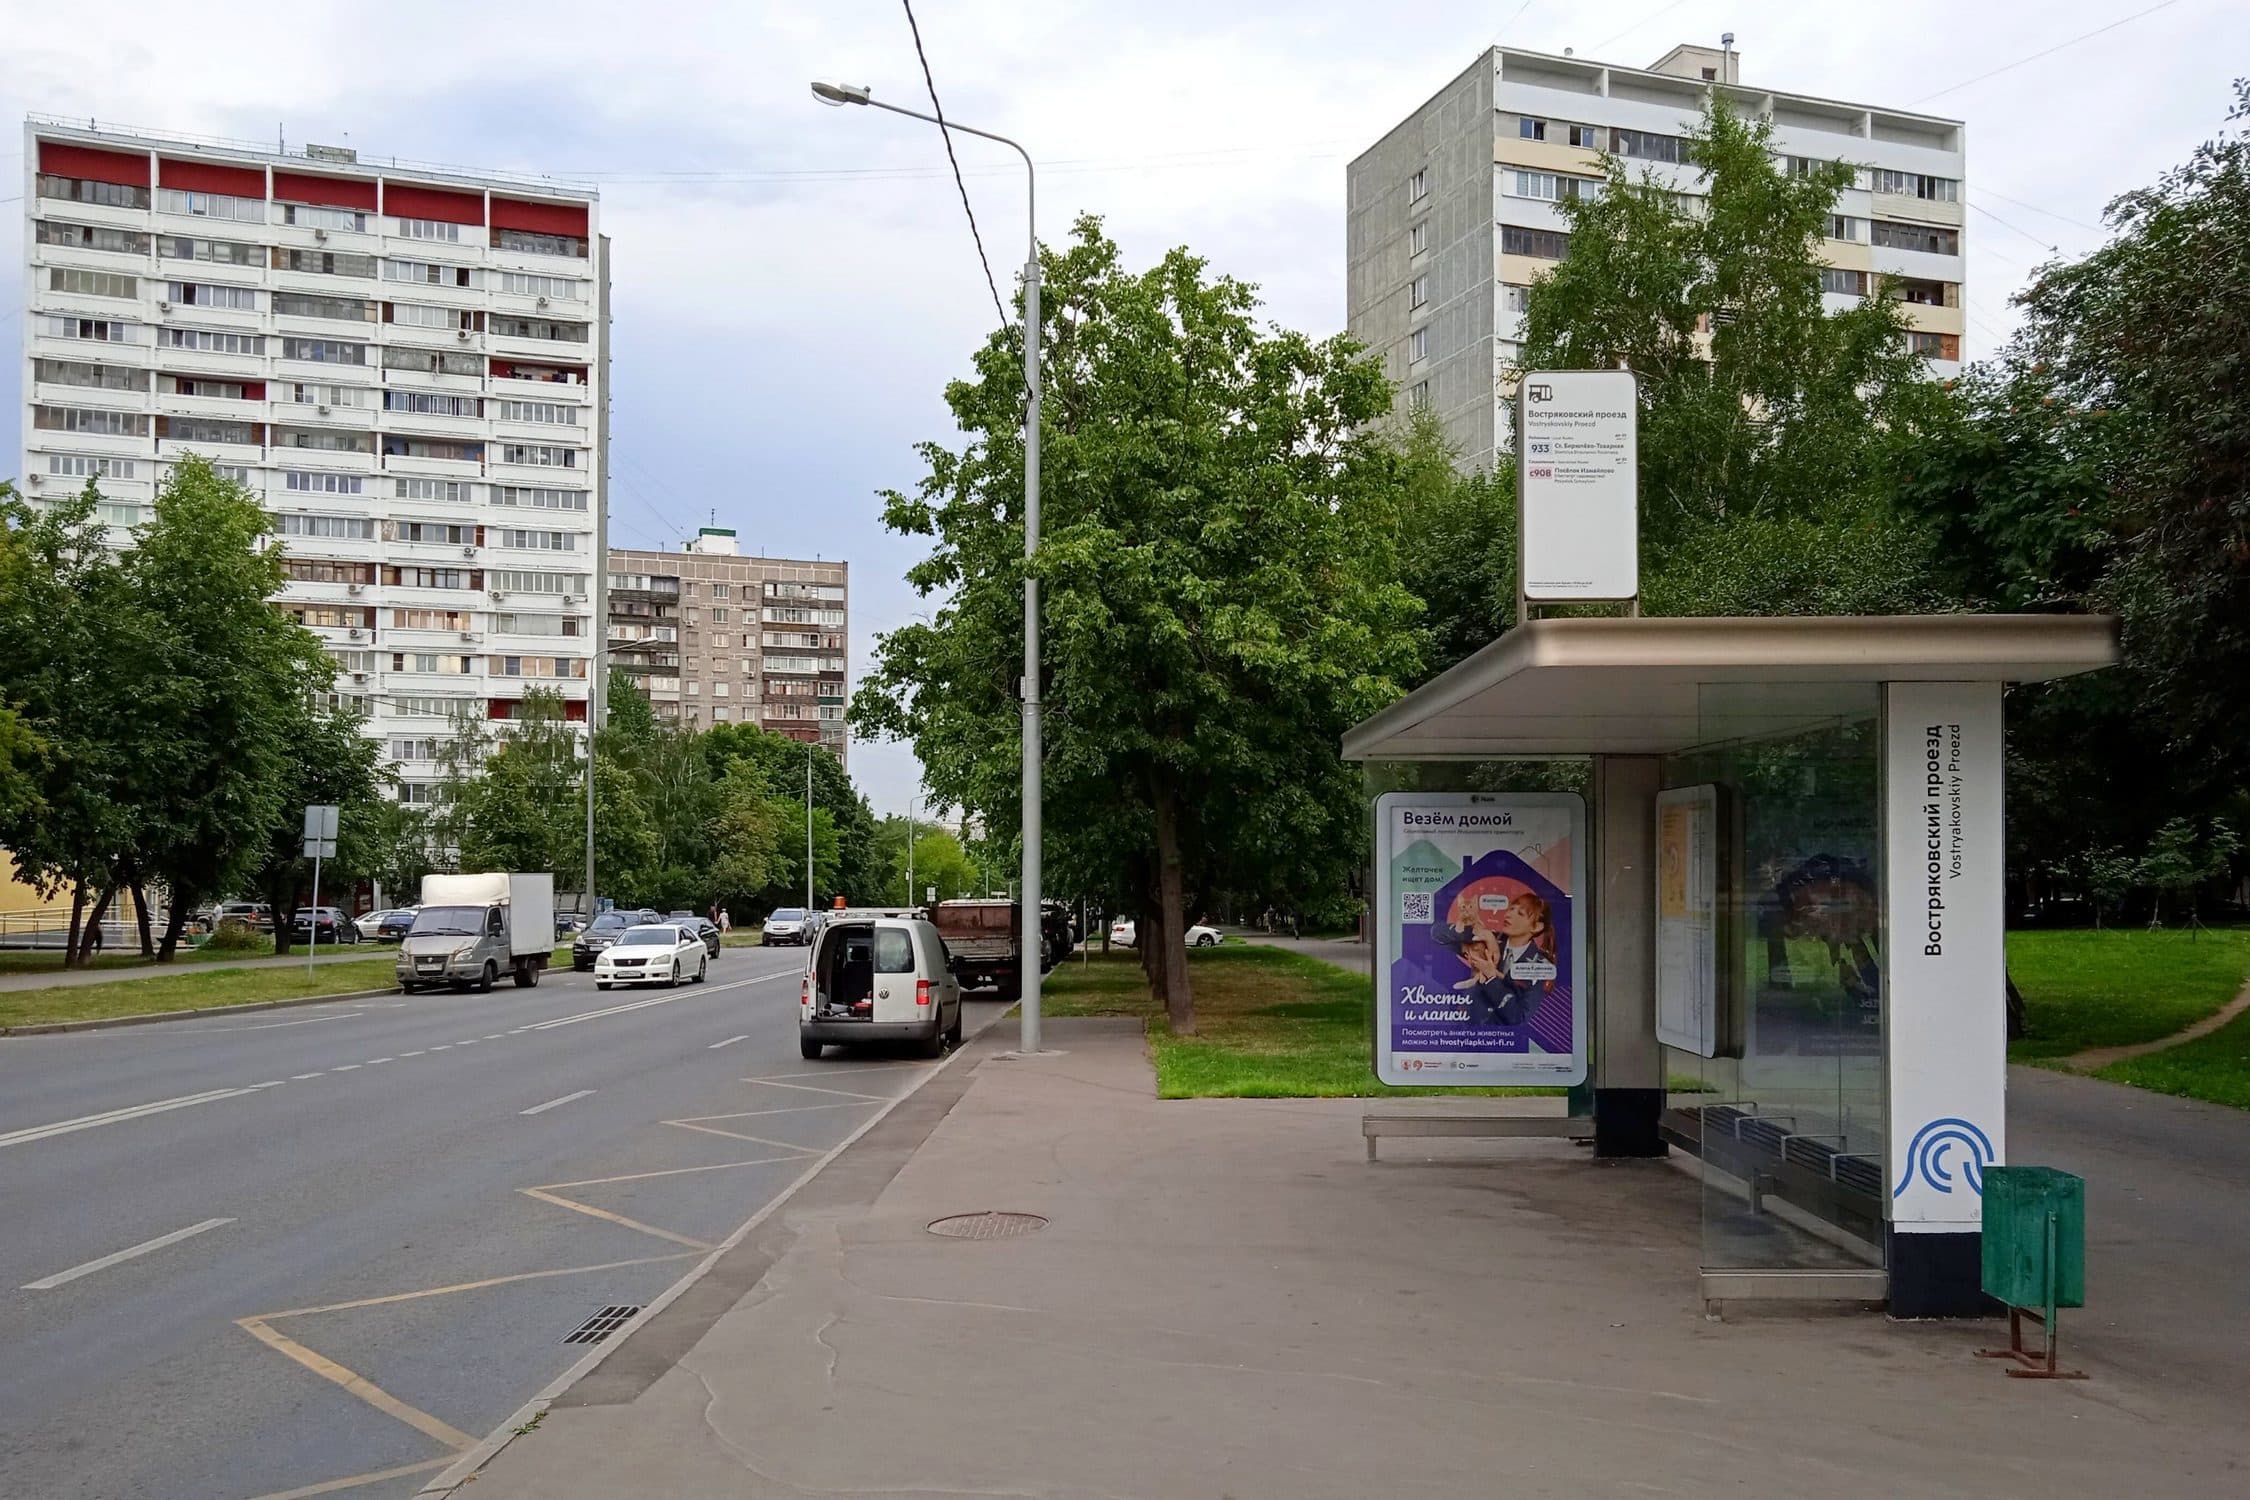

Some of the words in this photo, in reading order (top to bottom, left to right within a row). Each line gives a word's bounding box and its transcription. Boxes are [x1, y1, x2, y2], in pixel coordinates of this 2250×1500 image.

[1528, 410, 1593, 419] Востряковский
[1595, 411, 1627, 419] проезд
[1531, 444, 1550, 453] 933
[1948, 724, 1961, 772] Proezd
[1926, 725, 1944, 797] проезд
[1403, 811, 1455, 825] Везём
[1458, 812, 1512, 827] домой
[1948, 775, 1963, 879] Vostryakovskiy
[1923, 804, 1945, 956] Востряковский
[1401, 985, 1474, 1005] Хвосты
[1404, 1009, 1417, 1021] и
[1418, 1009, 1471, 1021] лапки
[1401, 1028, 1448, 1037] Посмотреть
